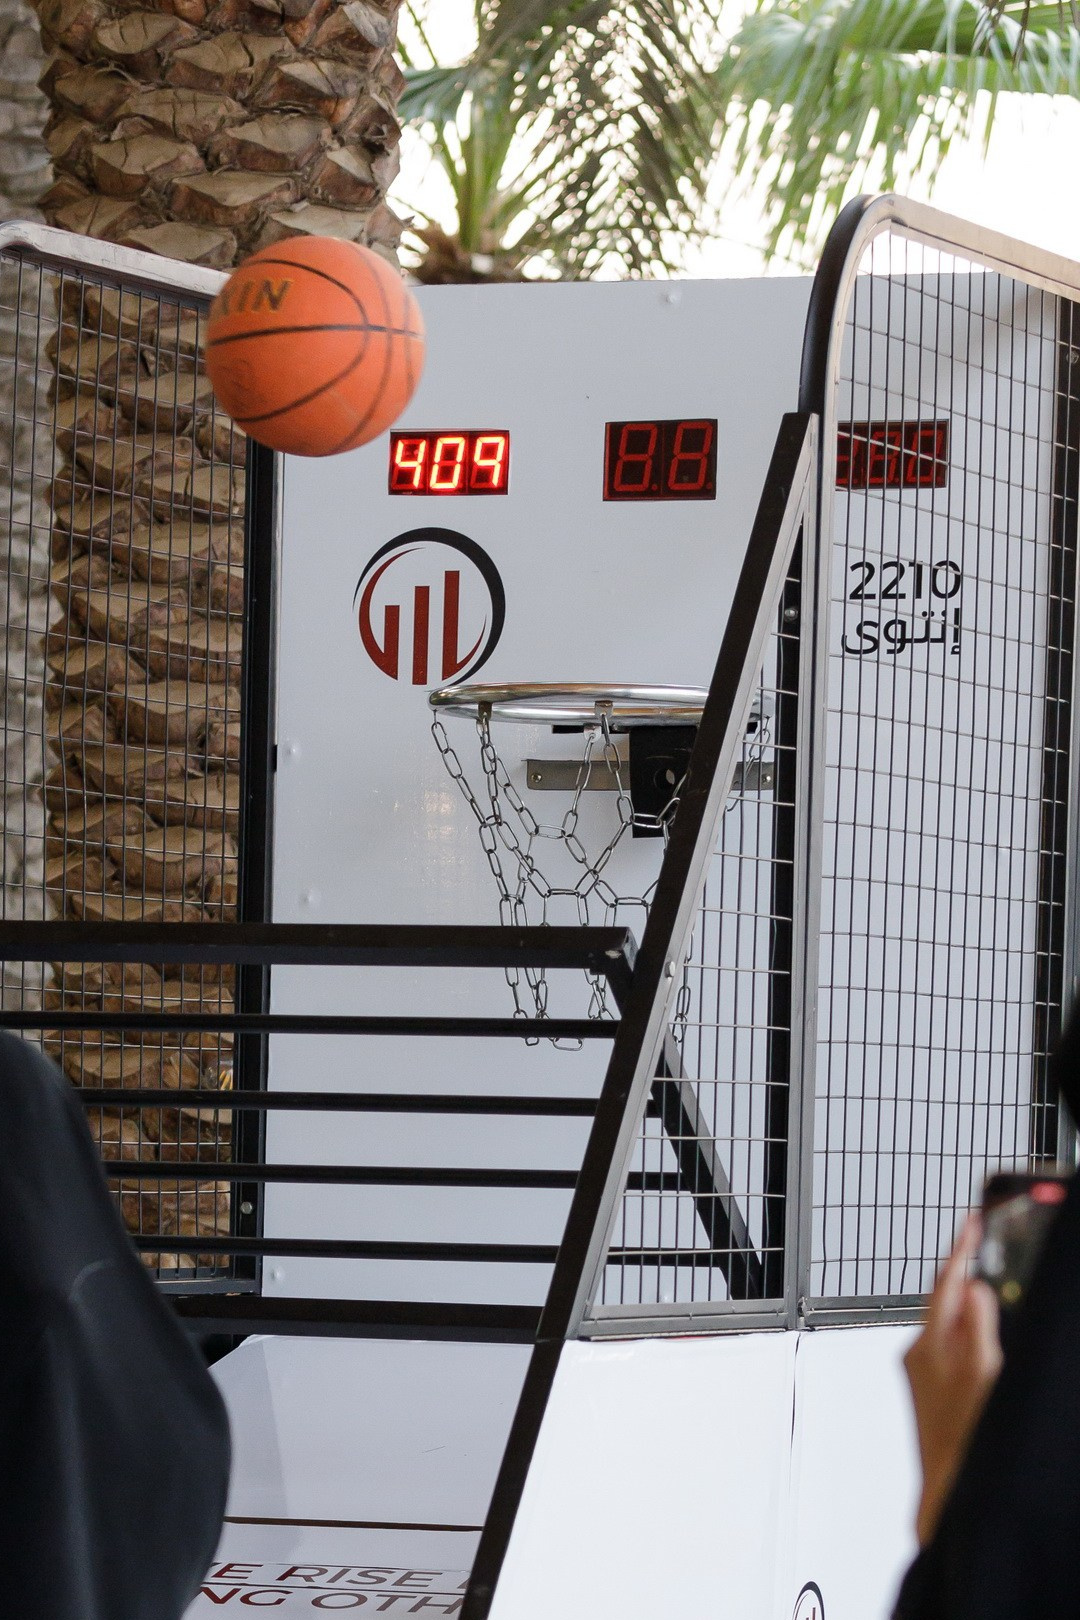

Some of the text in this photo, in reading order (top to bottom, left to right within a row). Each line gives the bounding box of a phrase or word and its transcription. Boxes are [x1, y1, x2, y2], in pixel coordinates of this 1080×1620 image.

[394, 436, 505, 489] 409
[849, 559, 962, 600] 2210
[275, 1566, 443, 1588] RISE
